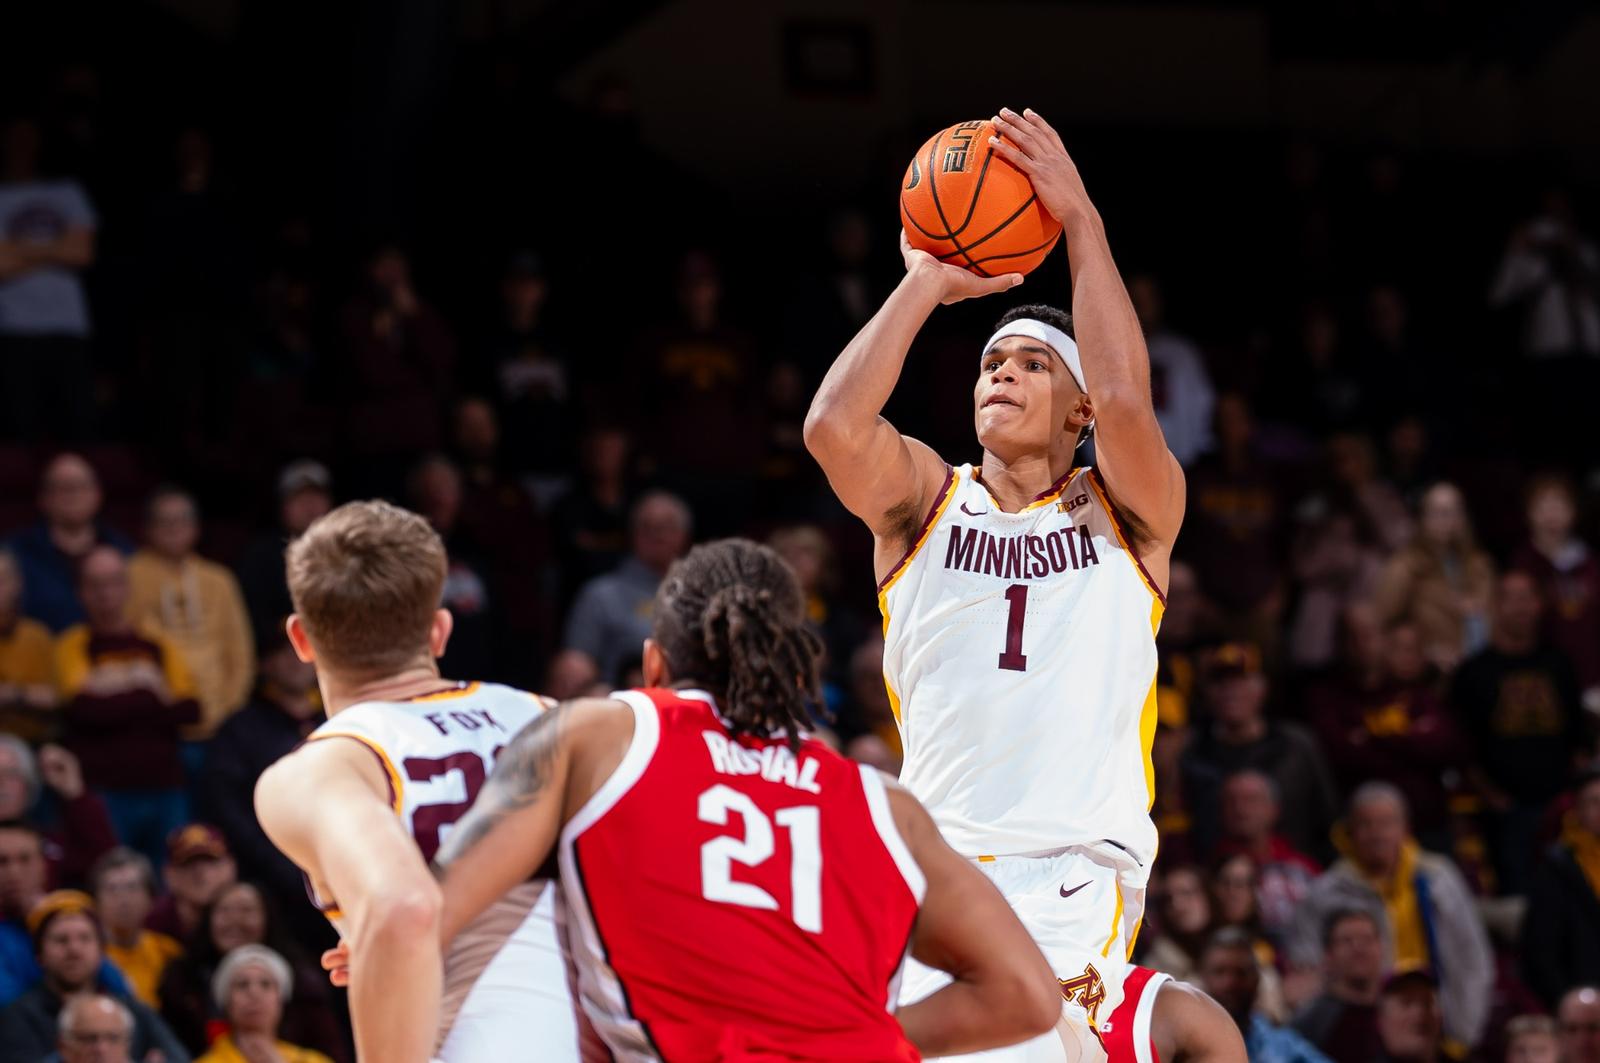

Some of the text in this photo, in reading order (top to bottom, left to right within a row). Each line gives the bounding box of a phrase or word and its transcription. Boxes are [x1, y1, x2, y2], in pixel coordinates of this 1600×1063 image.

[944, 524, 1100, 580] MINNESOTA
[998, 584, 1029, 672] 1
[424, 709, 507, 736] FOX
[701, 730, 821, 794] ROYAL
[403, 745, 505, 865] 2
[698, 783, 823, 935] 21
